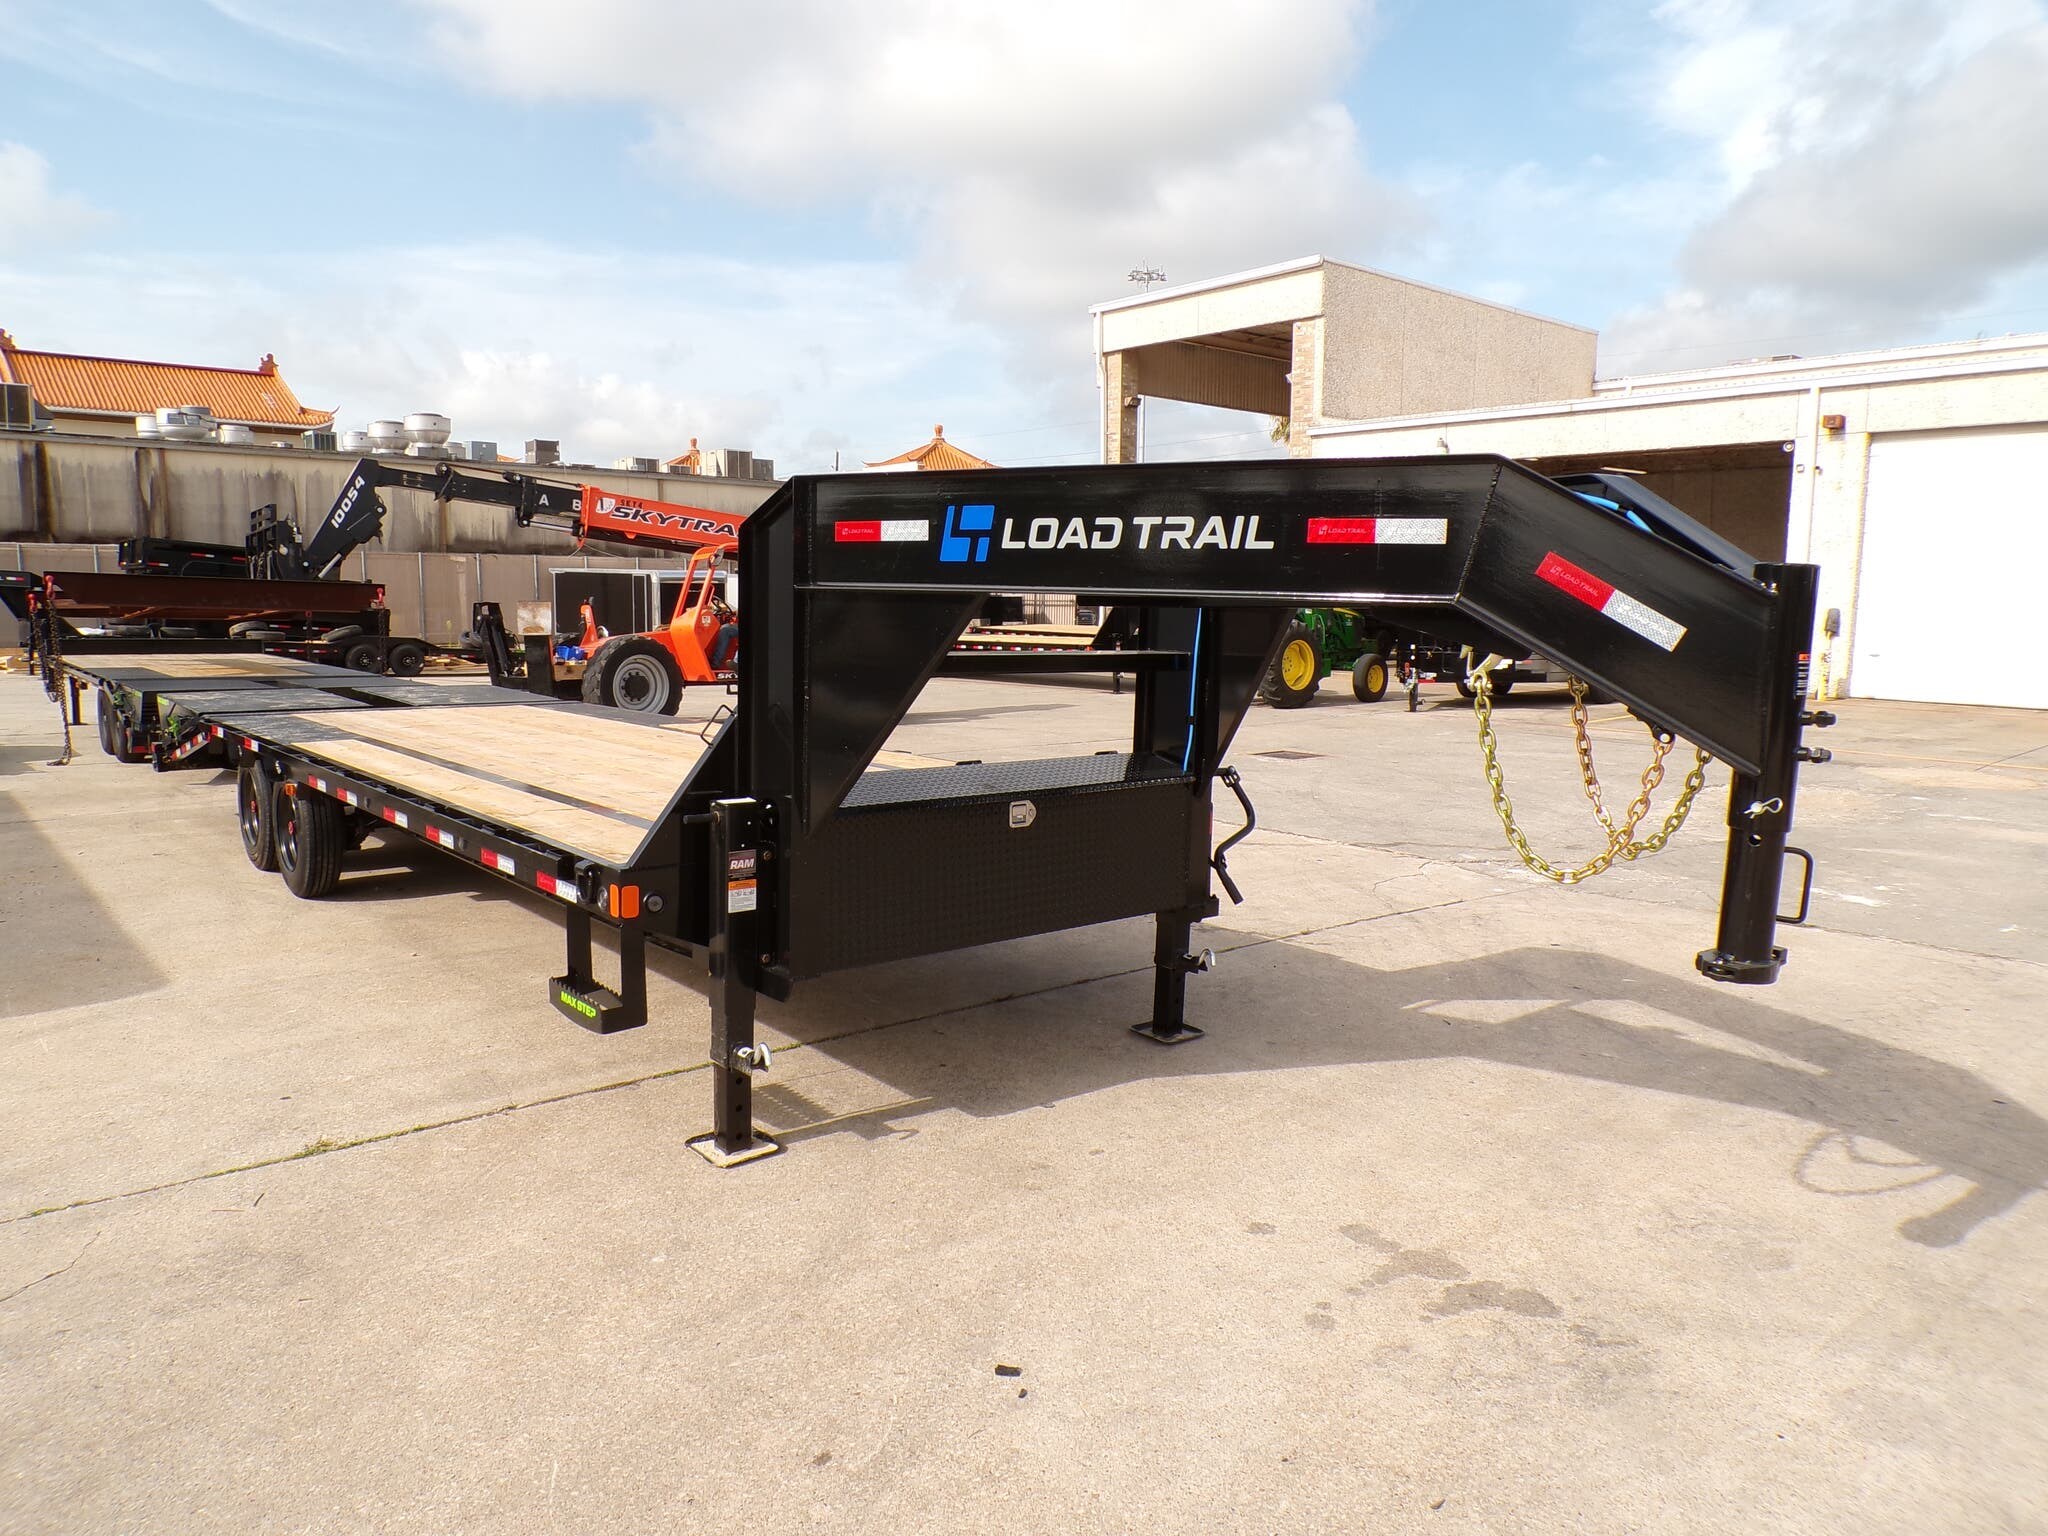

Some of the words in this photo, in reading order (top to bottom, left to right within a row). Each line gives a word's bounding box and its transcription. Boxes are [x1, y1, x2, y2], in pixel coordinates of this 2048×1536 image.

[330, 475, 366, 529] 10054
[538, 494, 550, 506] A
[572, 499, 582, 511] B
[610, 505, 738, 538] SKYTRA
[1001, 517, 1124, 550] LOAD
[1133, 515, 1275, 550] TRAIL
[730, 858, 755, 870] RAM
[561, 991, 577, 1008] MAX
[576, 1000, 596, 1018] STEP
